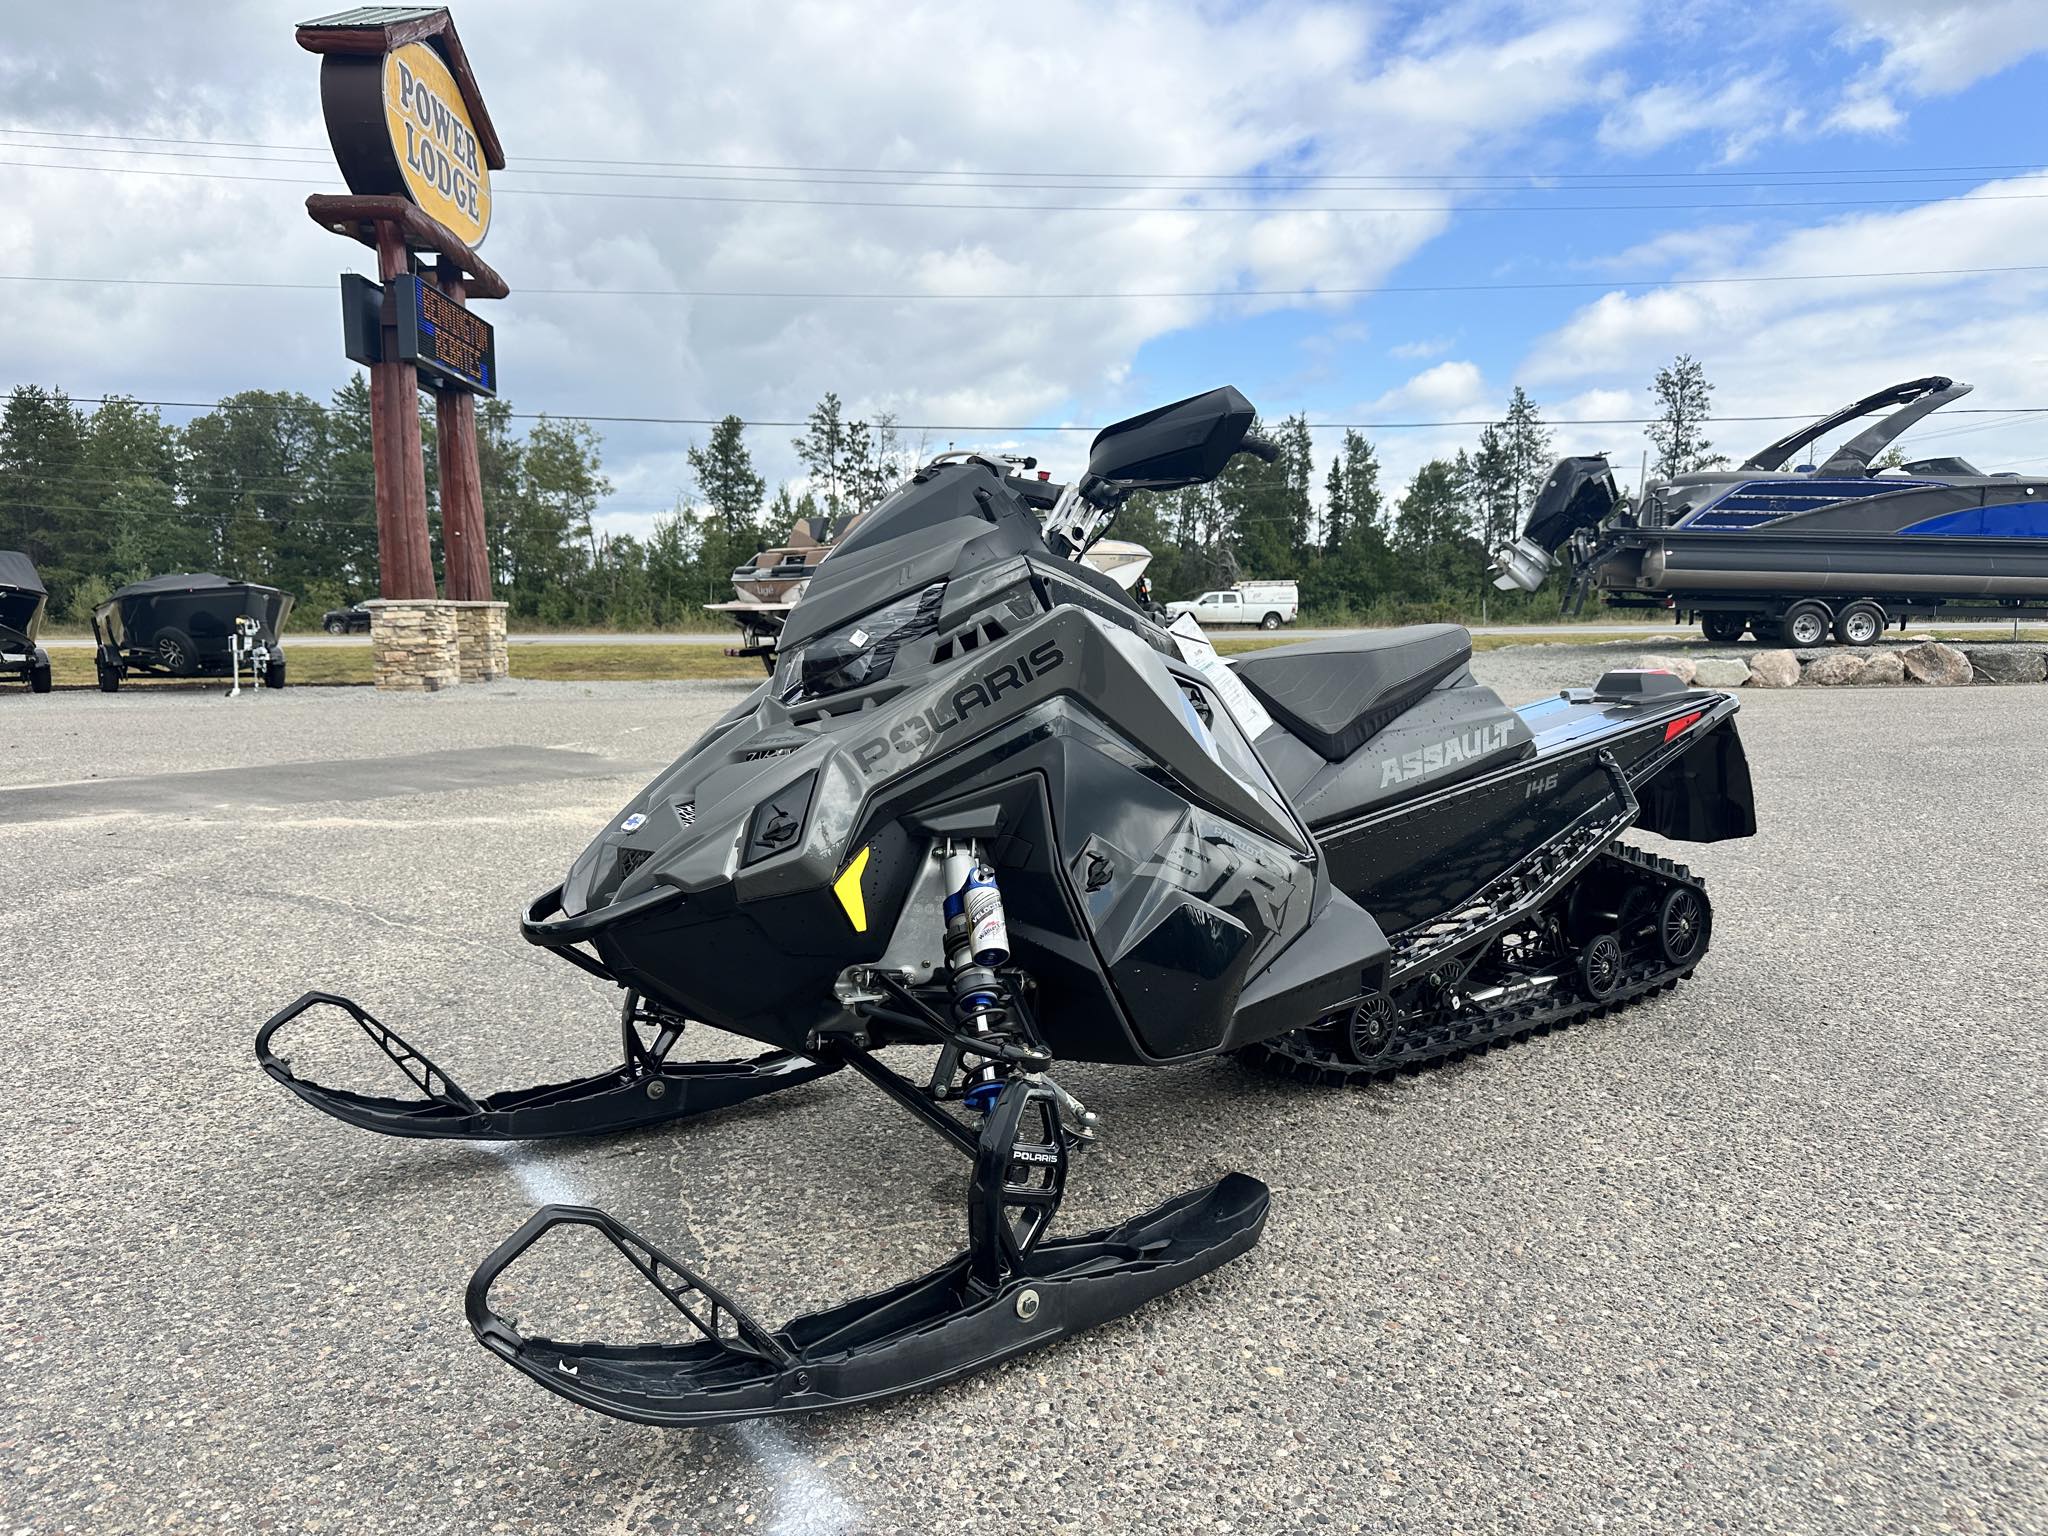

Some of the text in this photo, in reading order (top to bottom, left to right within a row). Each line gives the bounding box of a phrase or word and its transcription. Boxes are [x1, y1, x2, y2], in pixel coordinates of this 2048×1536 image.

[398, 61, 480, 179] POWER
[404, 121, 480, 223] LODGE
[852, 639, 1065, 776] POLARIS
[1379, 718, 1515, 789] ASSAULT
[1525, 773, 1559, 799] 146
[1213, 826, 1264, 859] PATRIOT
[1013, 1151, 1058, 1163] POLARIS
